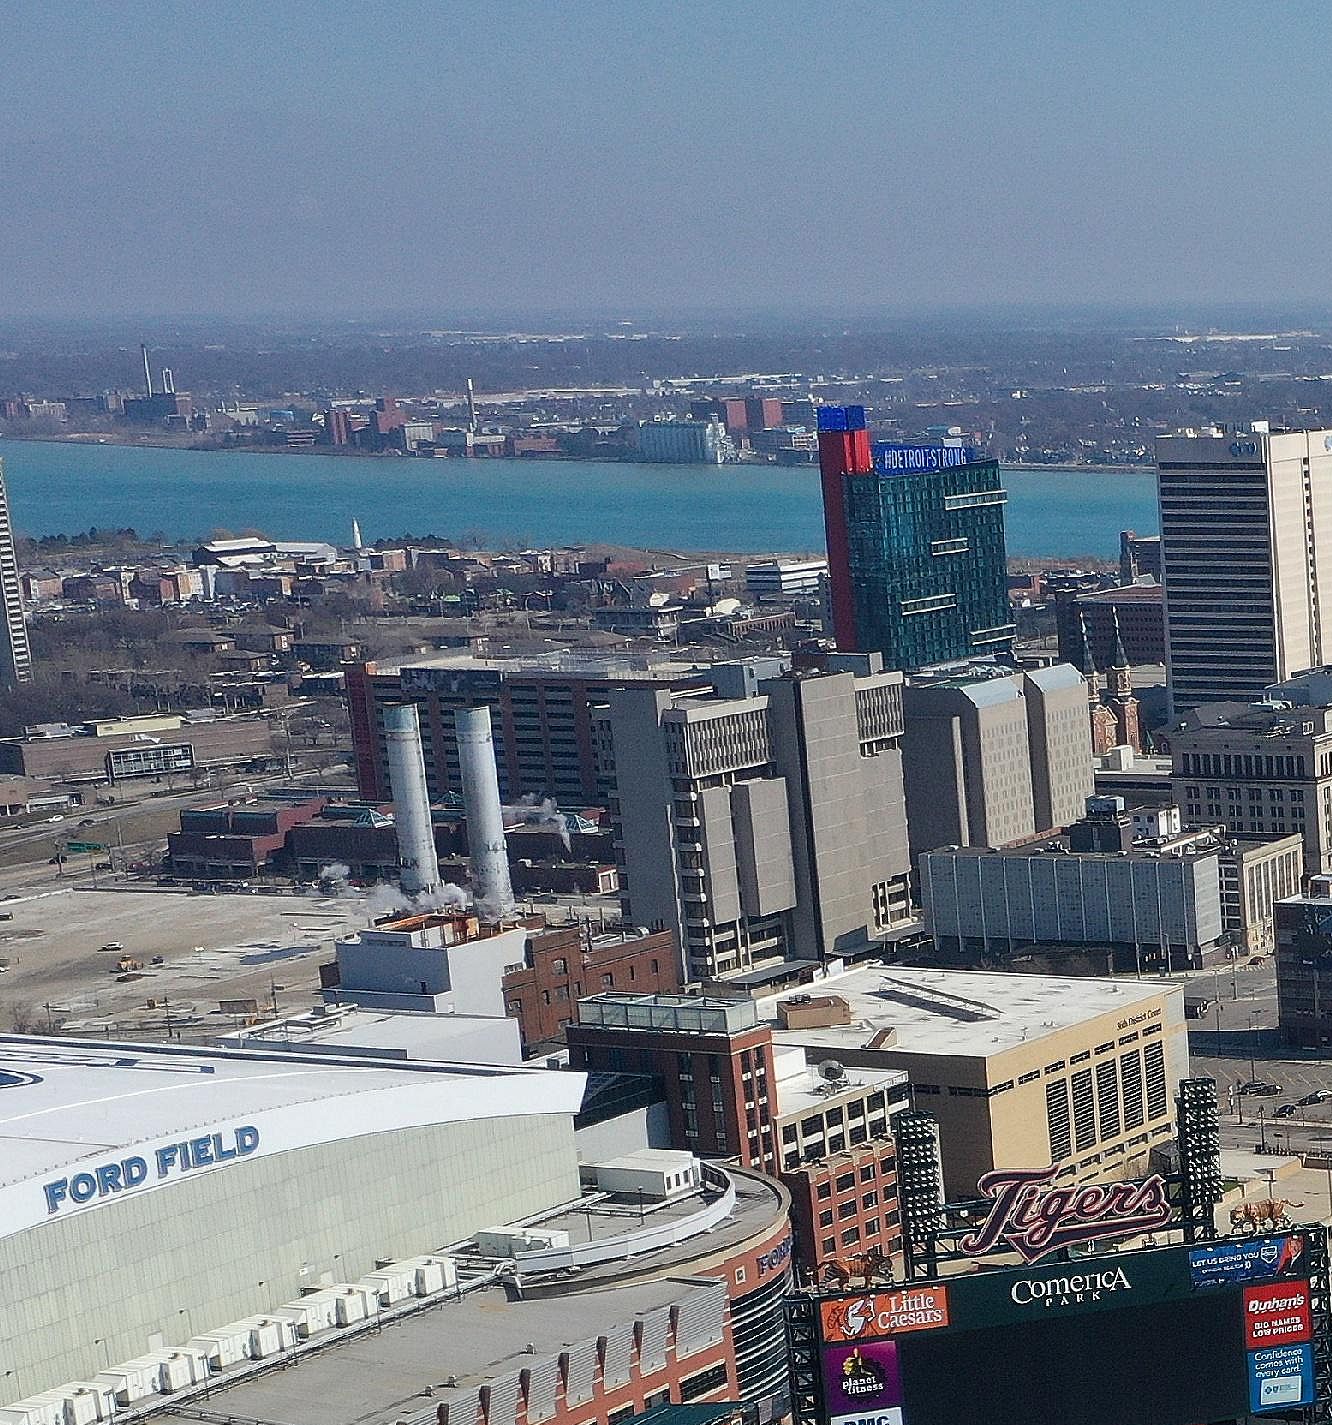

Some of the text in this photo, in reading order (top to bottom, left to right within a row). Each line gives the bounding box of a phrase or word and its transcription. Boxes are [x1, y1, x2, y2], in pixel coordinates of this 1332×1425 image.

[43, 1125, 260, 1215] FORD FIELD
[958, 1163, 1173, 1266] Tigers
[1243, 1251, 1260, 1260] YOU
[889, 1293, 935, 1313] Little
[1045, 1291, 1102, 1307] PARK
[1249, 1293, 1305, 1312] Dunham's
[878, 1309, 943, 1329] Caesars
[1271, 1316, 1301, 1327] NAMES
[1252, 1323, 1304, 1338] LOW PRICES
[1254, 1348, 1303, 1361] Confidence
[1255, 1356, 1304, 1370] comes with
[1255, 1369, 1280, 1378] every
[842, 1376, 877, 1390] planet
[847, 1382, 884, 1395] fitness
